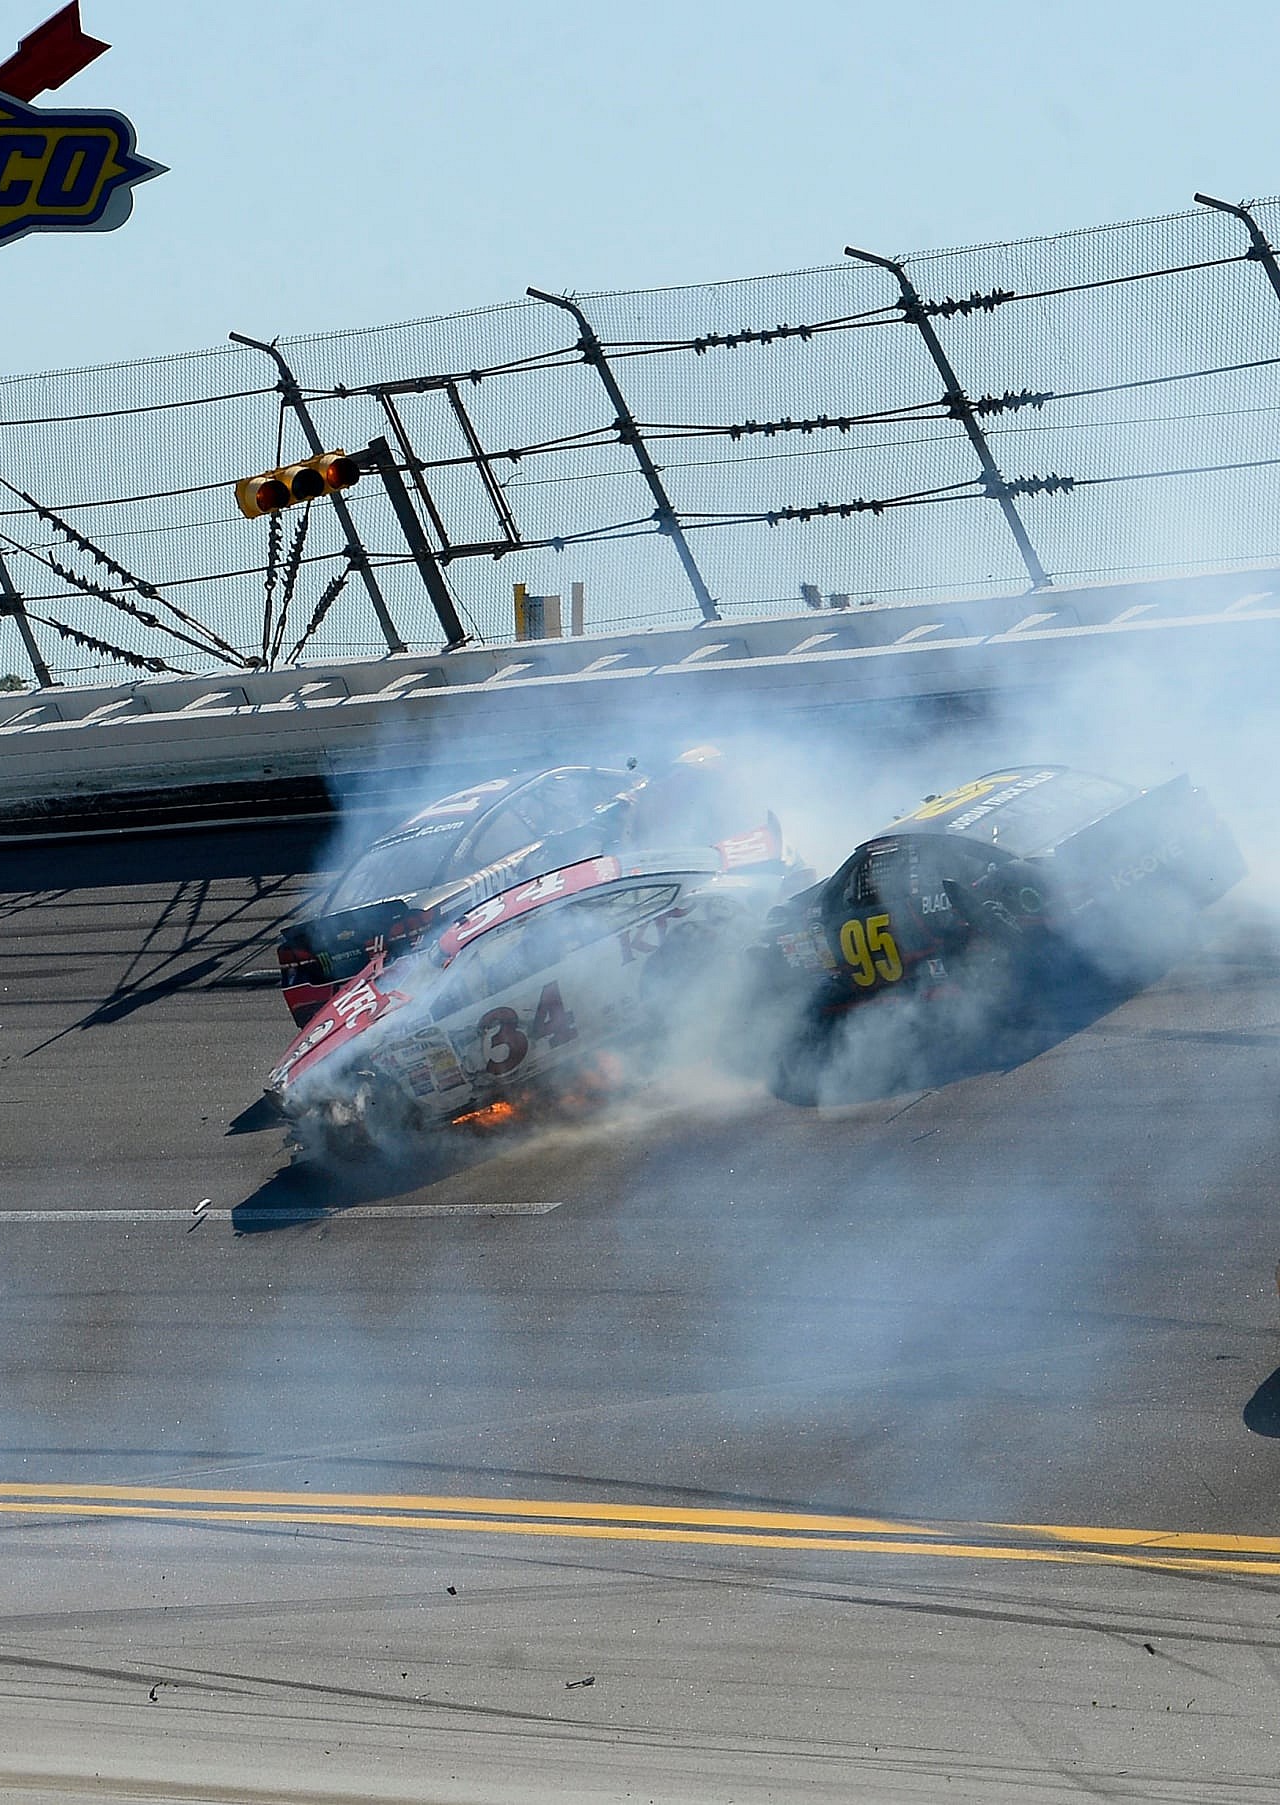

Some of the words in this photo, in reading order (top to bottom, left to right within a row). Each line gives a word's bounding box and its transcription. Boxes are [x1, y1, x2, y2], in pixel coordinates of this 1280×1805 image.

[839, 913, 903, 987] 95
[332, 978, 378, 1030] KFC
[478, 978, 579, 1076] 34
